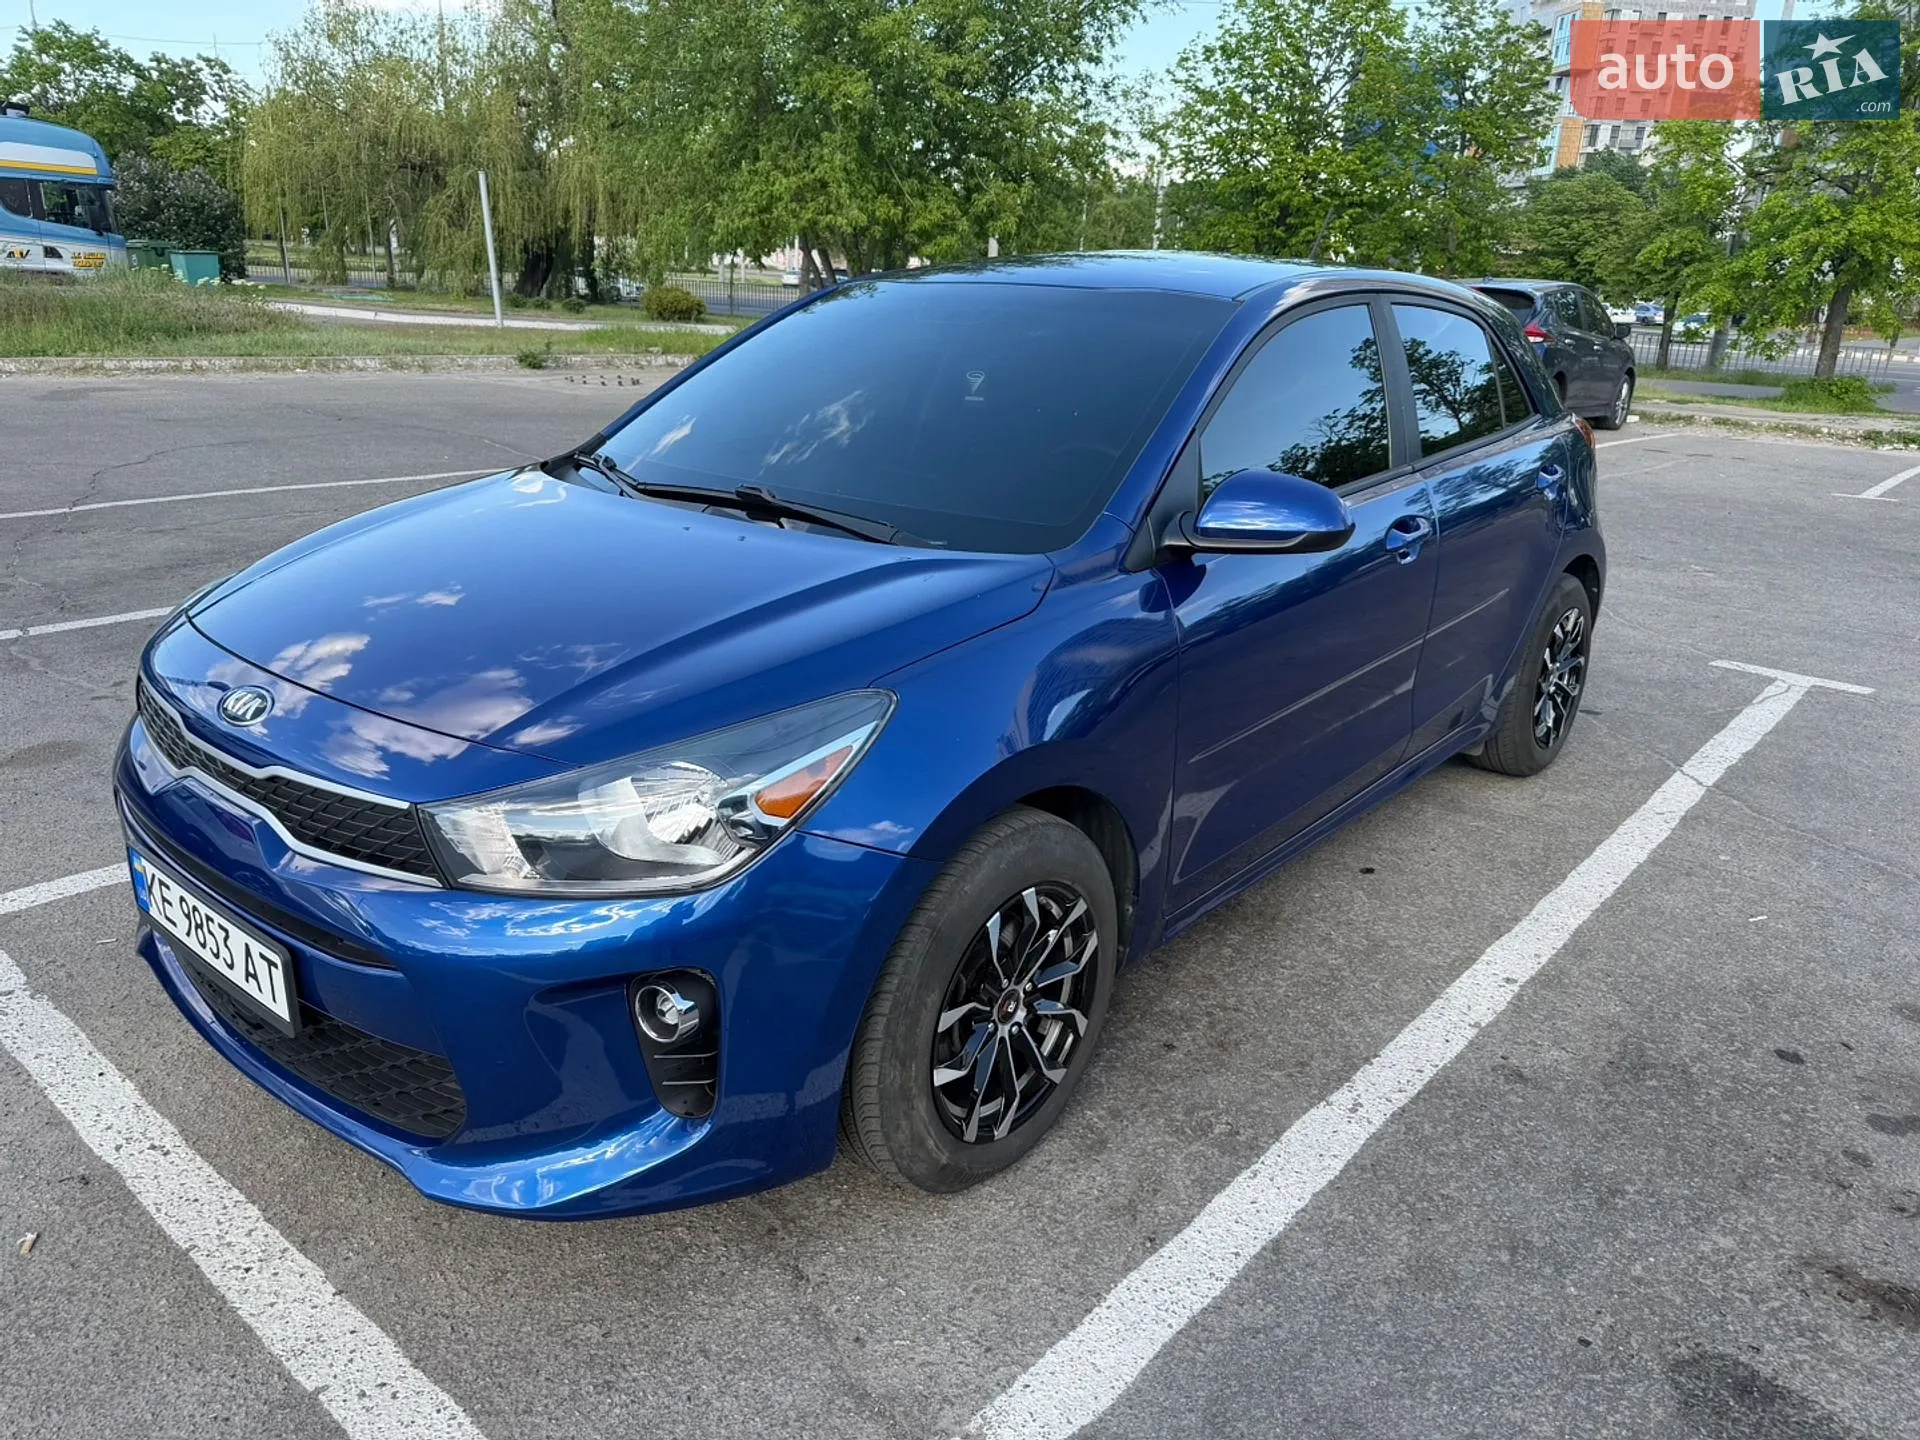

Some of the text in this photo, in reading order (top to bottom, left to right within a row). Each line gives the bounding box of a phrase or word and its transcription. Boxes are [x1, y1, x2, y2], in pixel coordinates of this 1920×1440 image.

[223, 691, 262, 720] KIA
[179, 894, 235, 971] 9853
[243, 942, 279, 1005] AT
